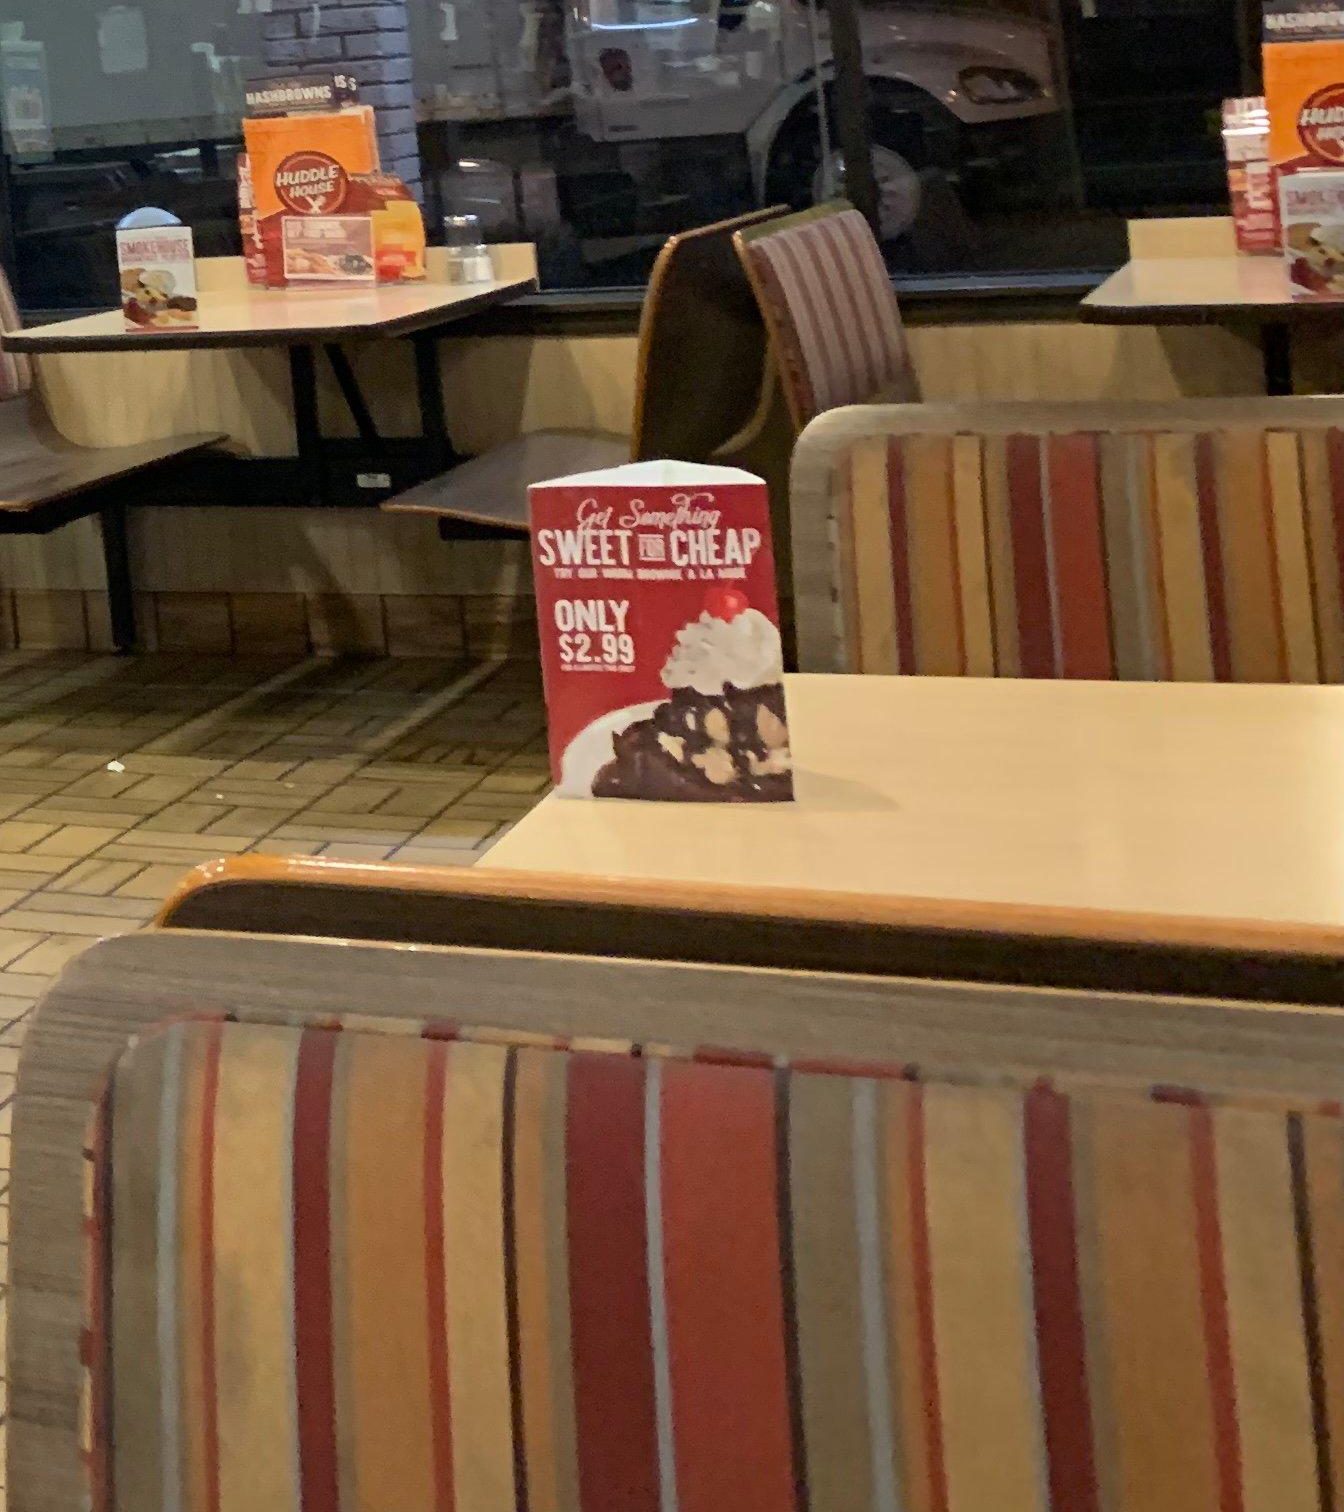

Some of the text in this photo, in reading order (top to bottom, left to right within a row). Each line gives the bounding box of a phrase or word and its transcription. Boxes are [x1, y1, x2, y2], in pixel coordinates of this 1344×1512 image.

[275, 164, 339, 188] HUDDLE
[289, 181, 334, 199] HOUSE
[576, 492, 721, 532] Get Something
[537, 528, 633, 566] SWEET
[669, 527, 761, 566] CHEAP
[554, 599, 629, 632] ONLY
[558, 633, 635, 664] $2.99
